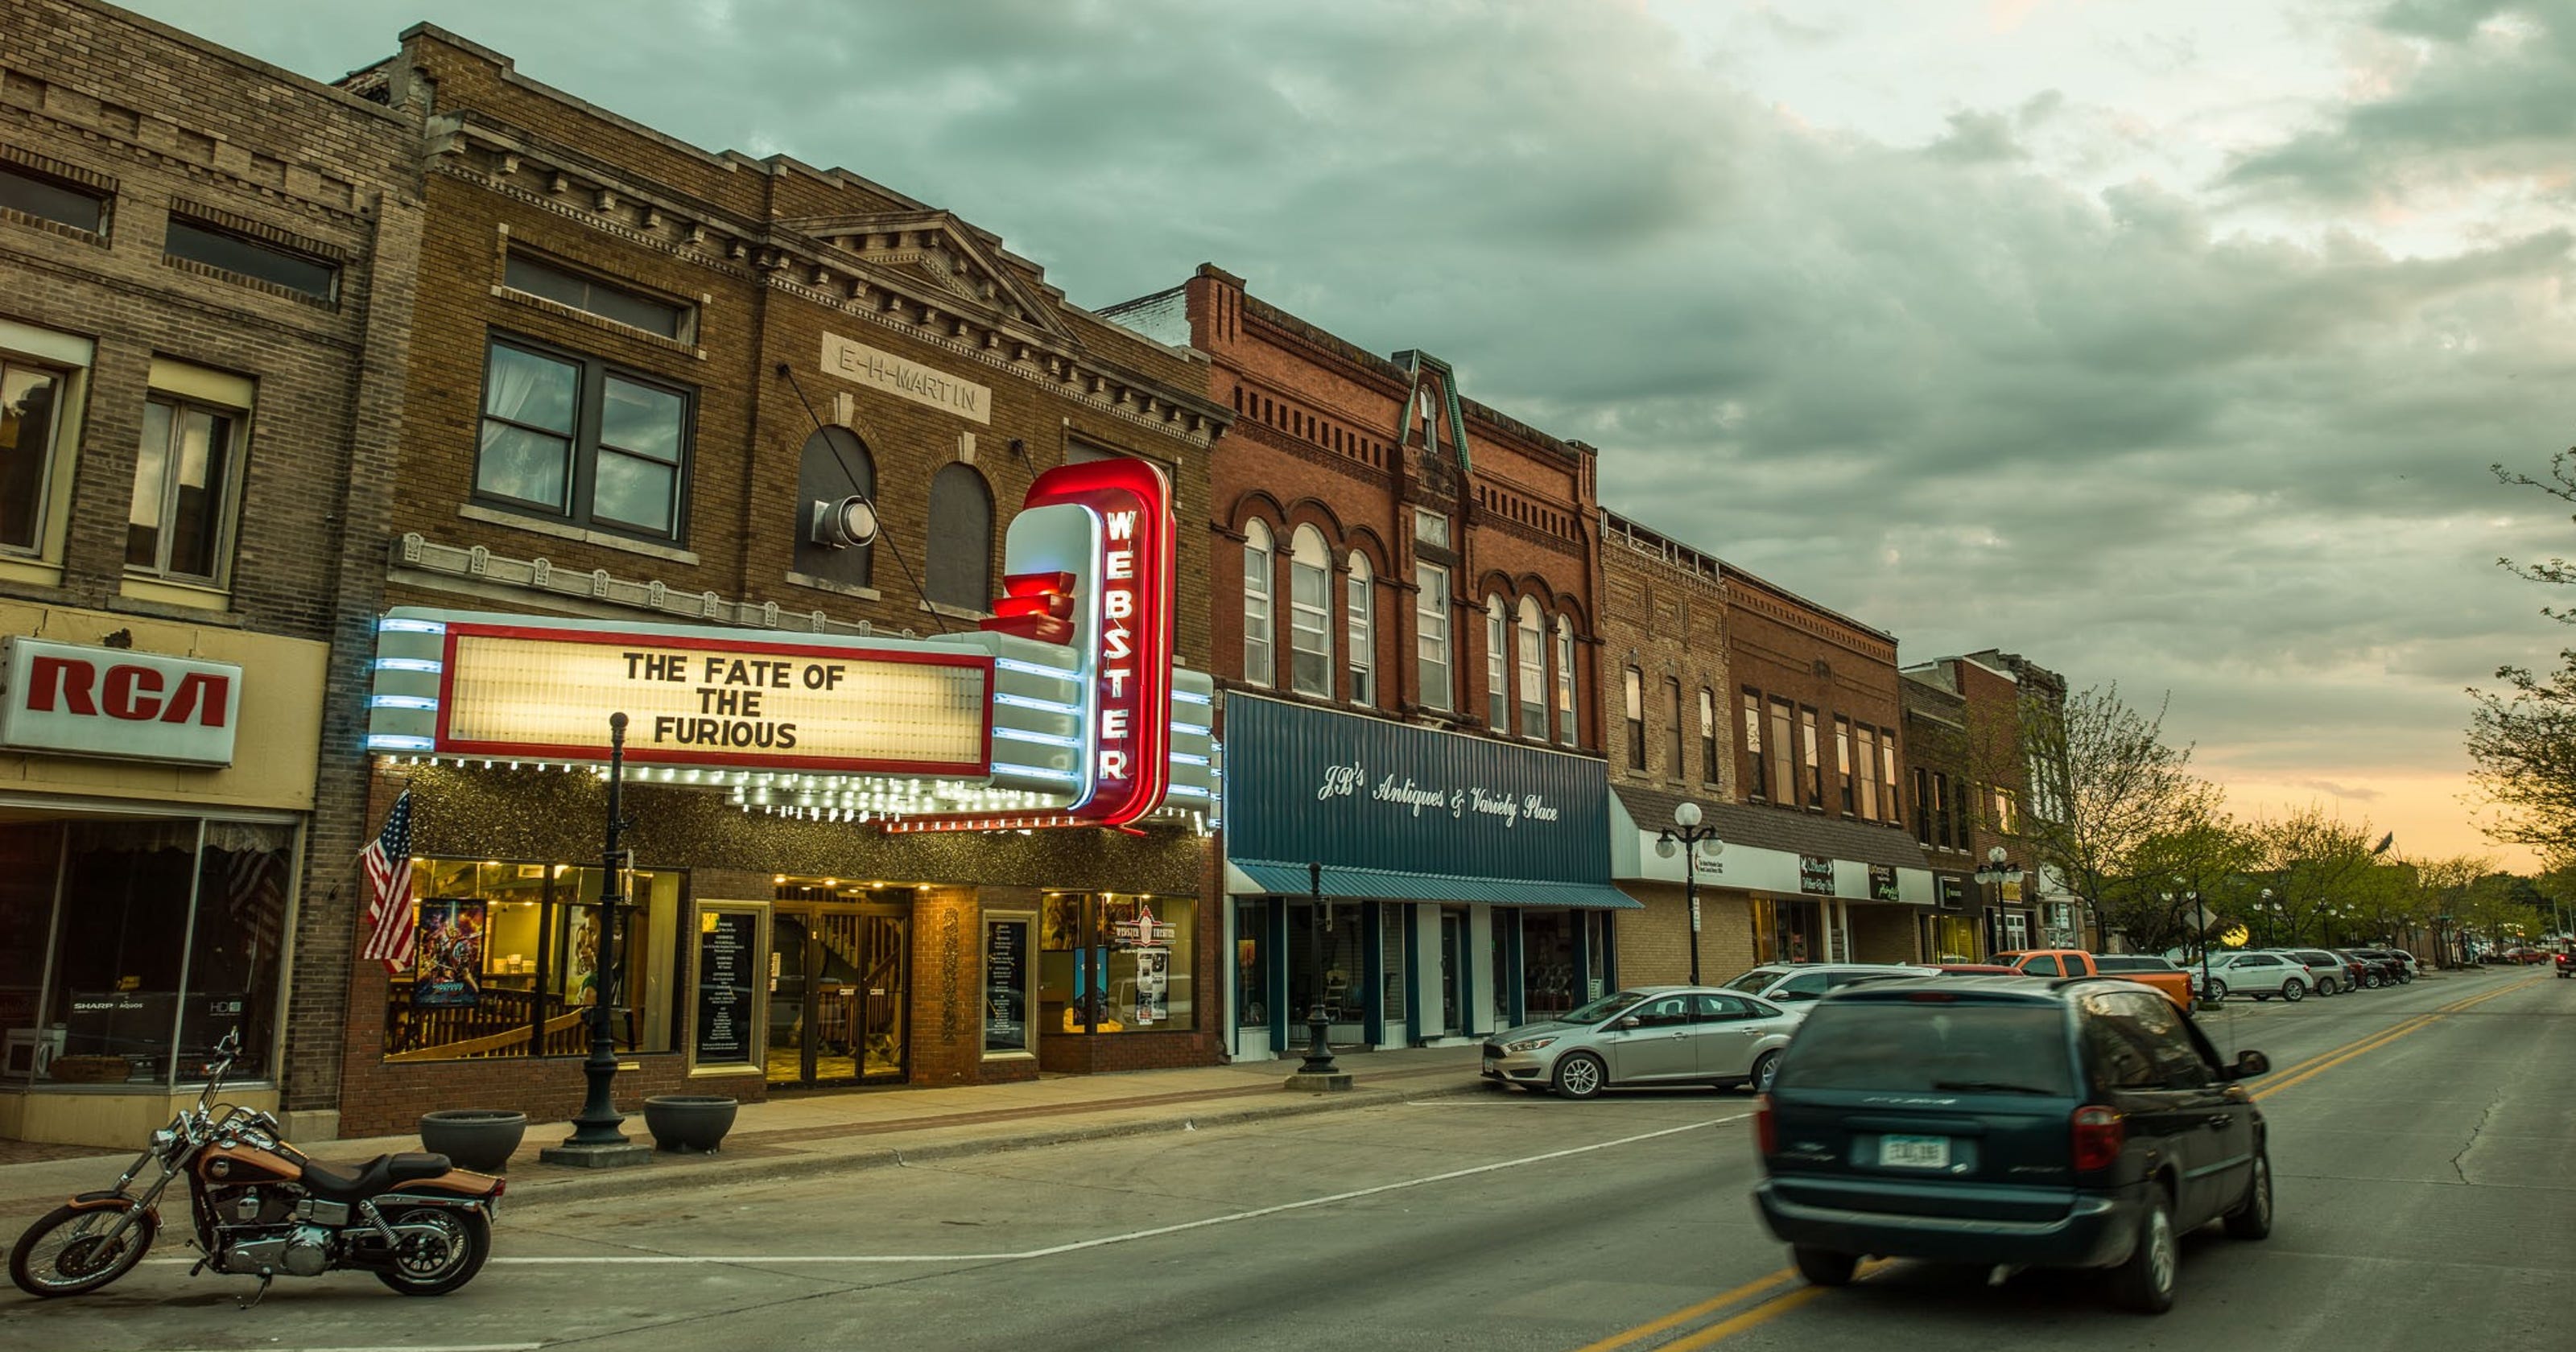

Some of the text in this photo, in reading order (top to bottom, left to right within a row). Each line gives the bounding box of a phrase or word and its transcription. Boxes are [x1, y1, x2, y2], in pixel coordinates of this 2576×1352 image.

[840, 345, 976, 412] E-H-MARTIN
[623, 653, 845, 690] THE FATE OF
[1099, 510, 1137, 779] WEBSTER
[27, 656, 229, 728] RCA
[696, 687, 762, 717] THE
[654, 716, 796, 748] FURIOUS
[1318, 761, 1558, 827] JB's Antiques & Variety Place
